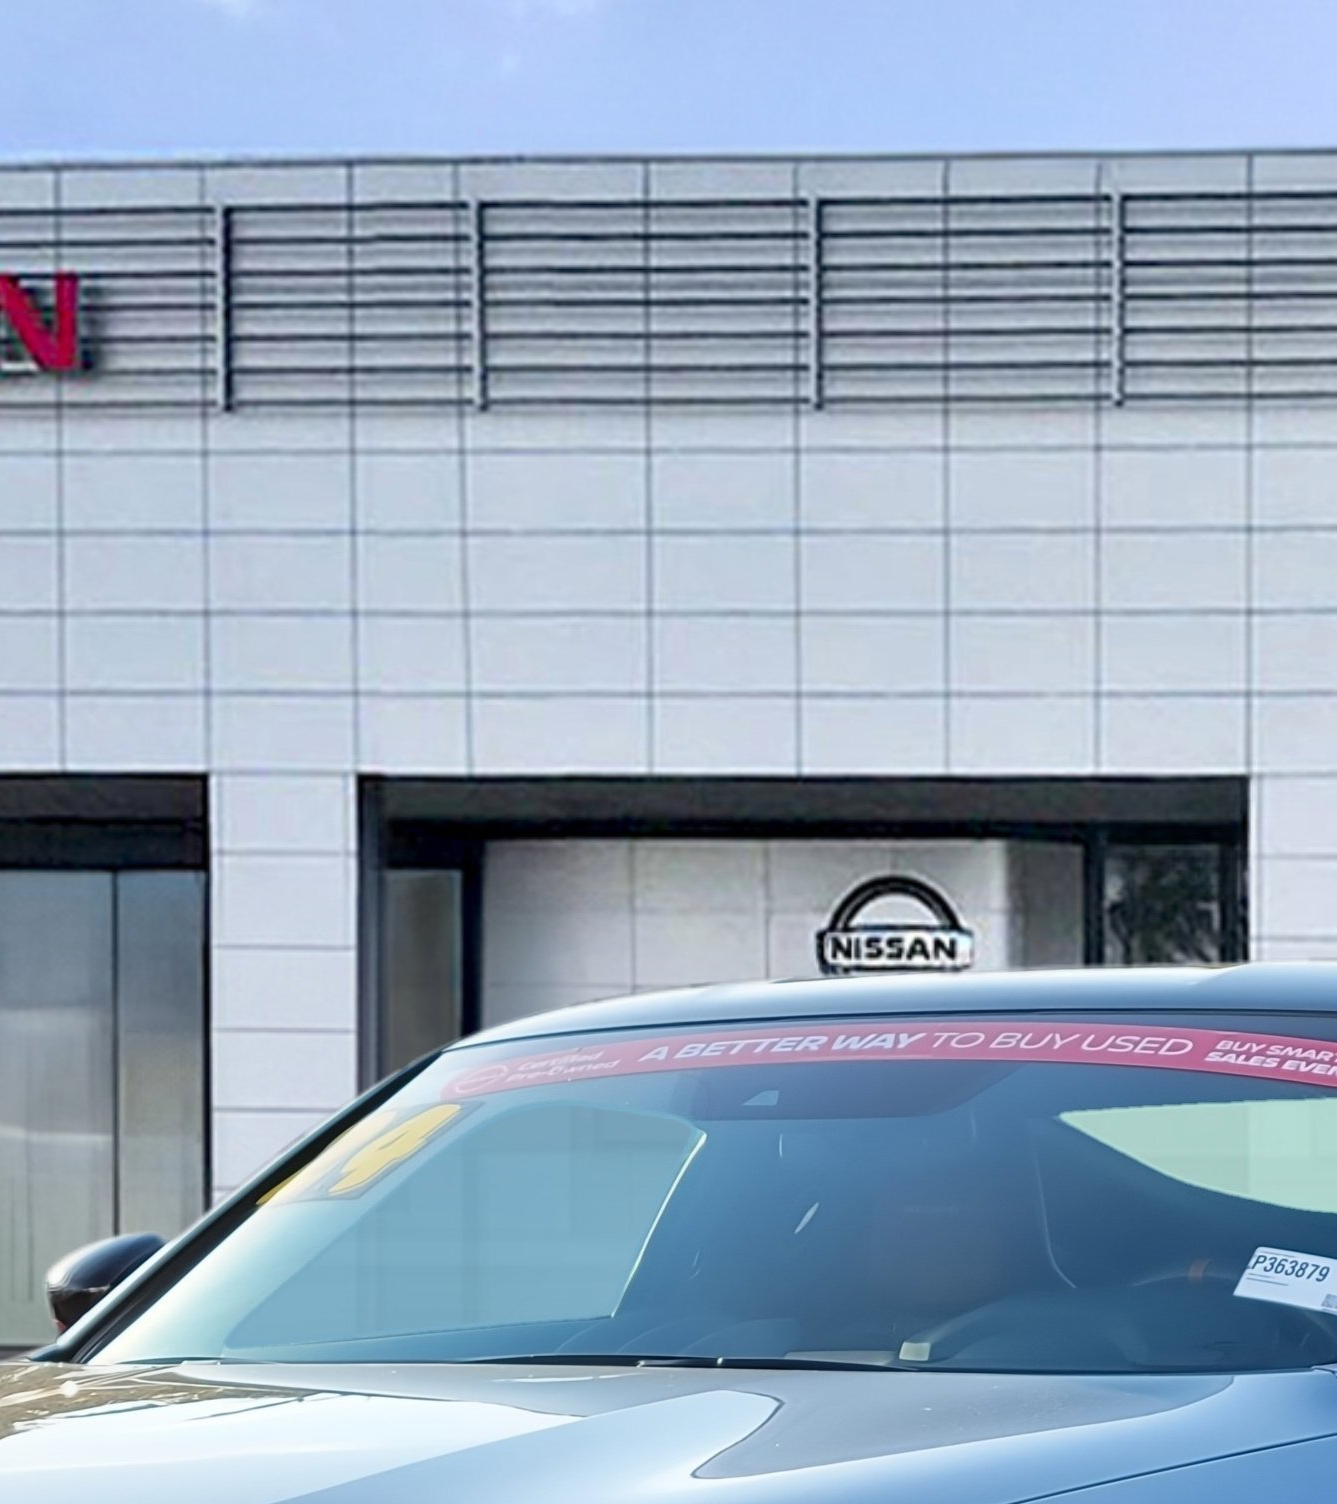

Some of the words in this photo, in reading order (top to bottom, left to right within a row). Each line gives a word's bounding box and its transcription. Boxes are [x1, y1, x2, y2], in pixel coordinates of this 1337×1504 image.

[830, 936, 957, 961] NISSAN
[637, 1046, 669, 1063] A
[673, 1035, 829, 1059] BETTER
[830, 1032, 928, 1051] WAY
[931, 1032, 985, 1049] TO
[988, 1032, 1081, 1050] BUY
[1080, 1034, 1194, 1056] USED
[1215, 1040, 1268, 1052] BUY
[1204, 1051, 1279, 1068] SALES
